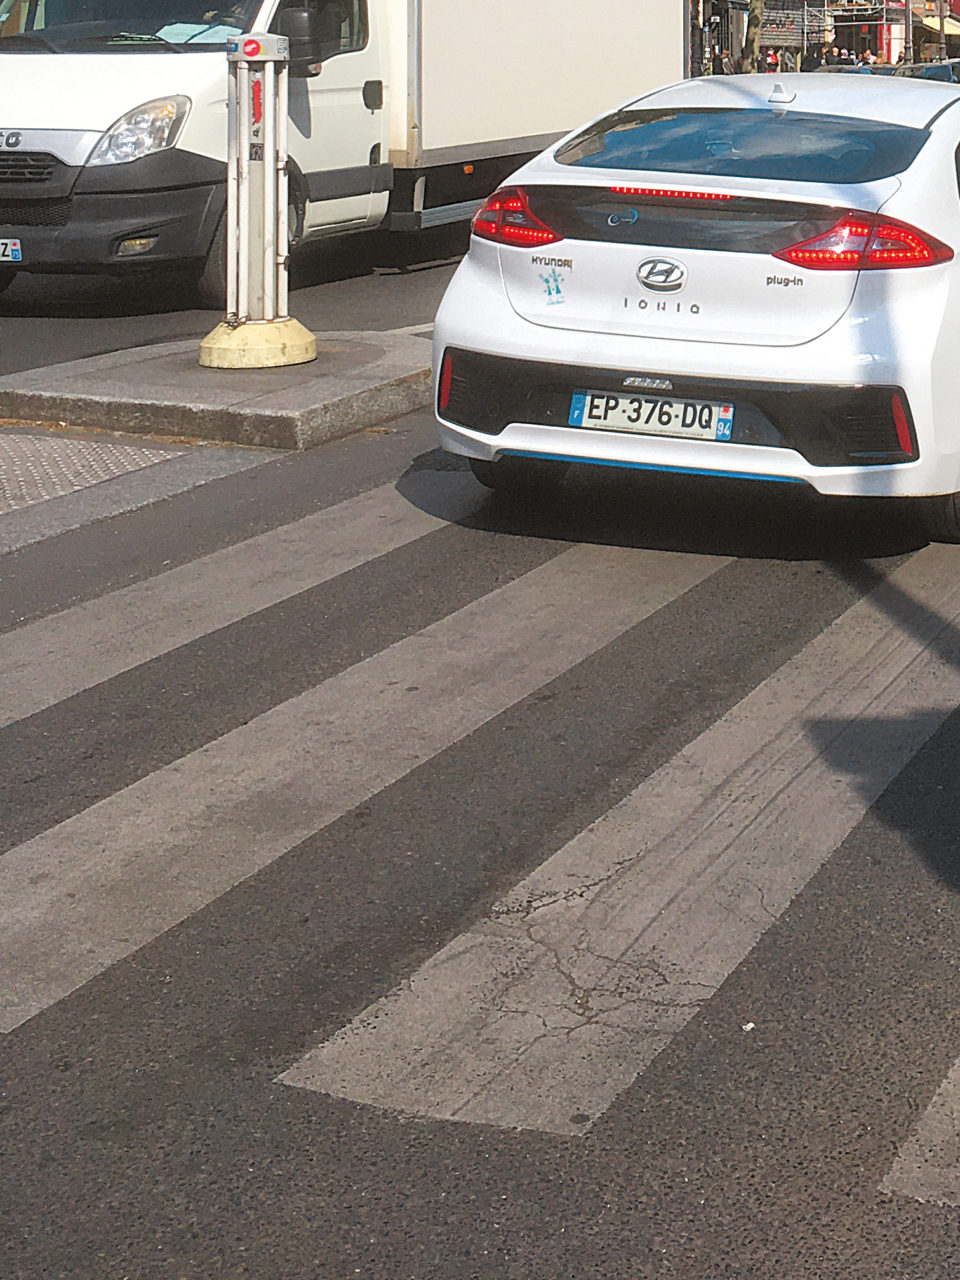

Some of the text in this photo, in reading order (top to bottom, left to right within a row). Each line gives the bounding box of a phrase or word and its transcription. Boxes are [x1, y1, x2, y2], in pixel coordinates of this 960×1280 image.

[531, 255, 573, 269] HYUNDAI
[766, 275, 804, 287] plug-in
[623, 296, 701, 314] IONIQ
[573, 410, 580, 419] F
[588, 393, 714, 430] EP-376-DQ
[716, 422, 731, 436] 94
